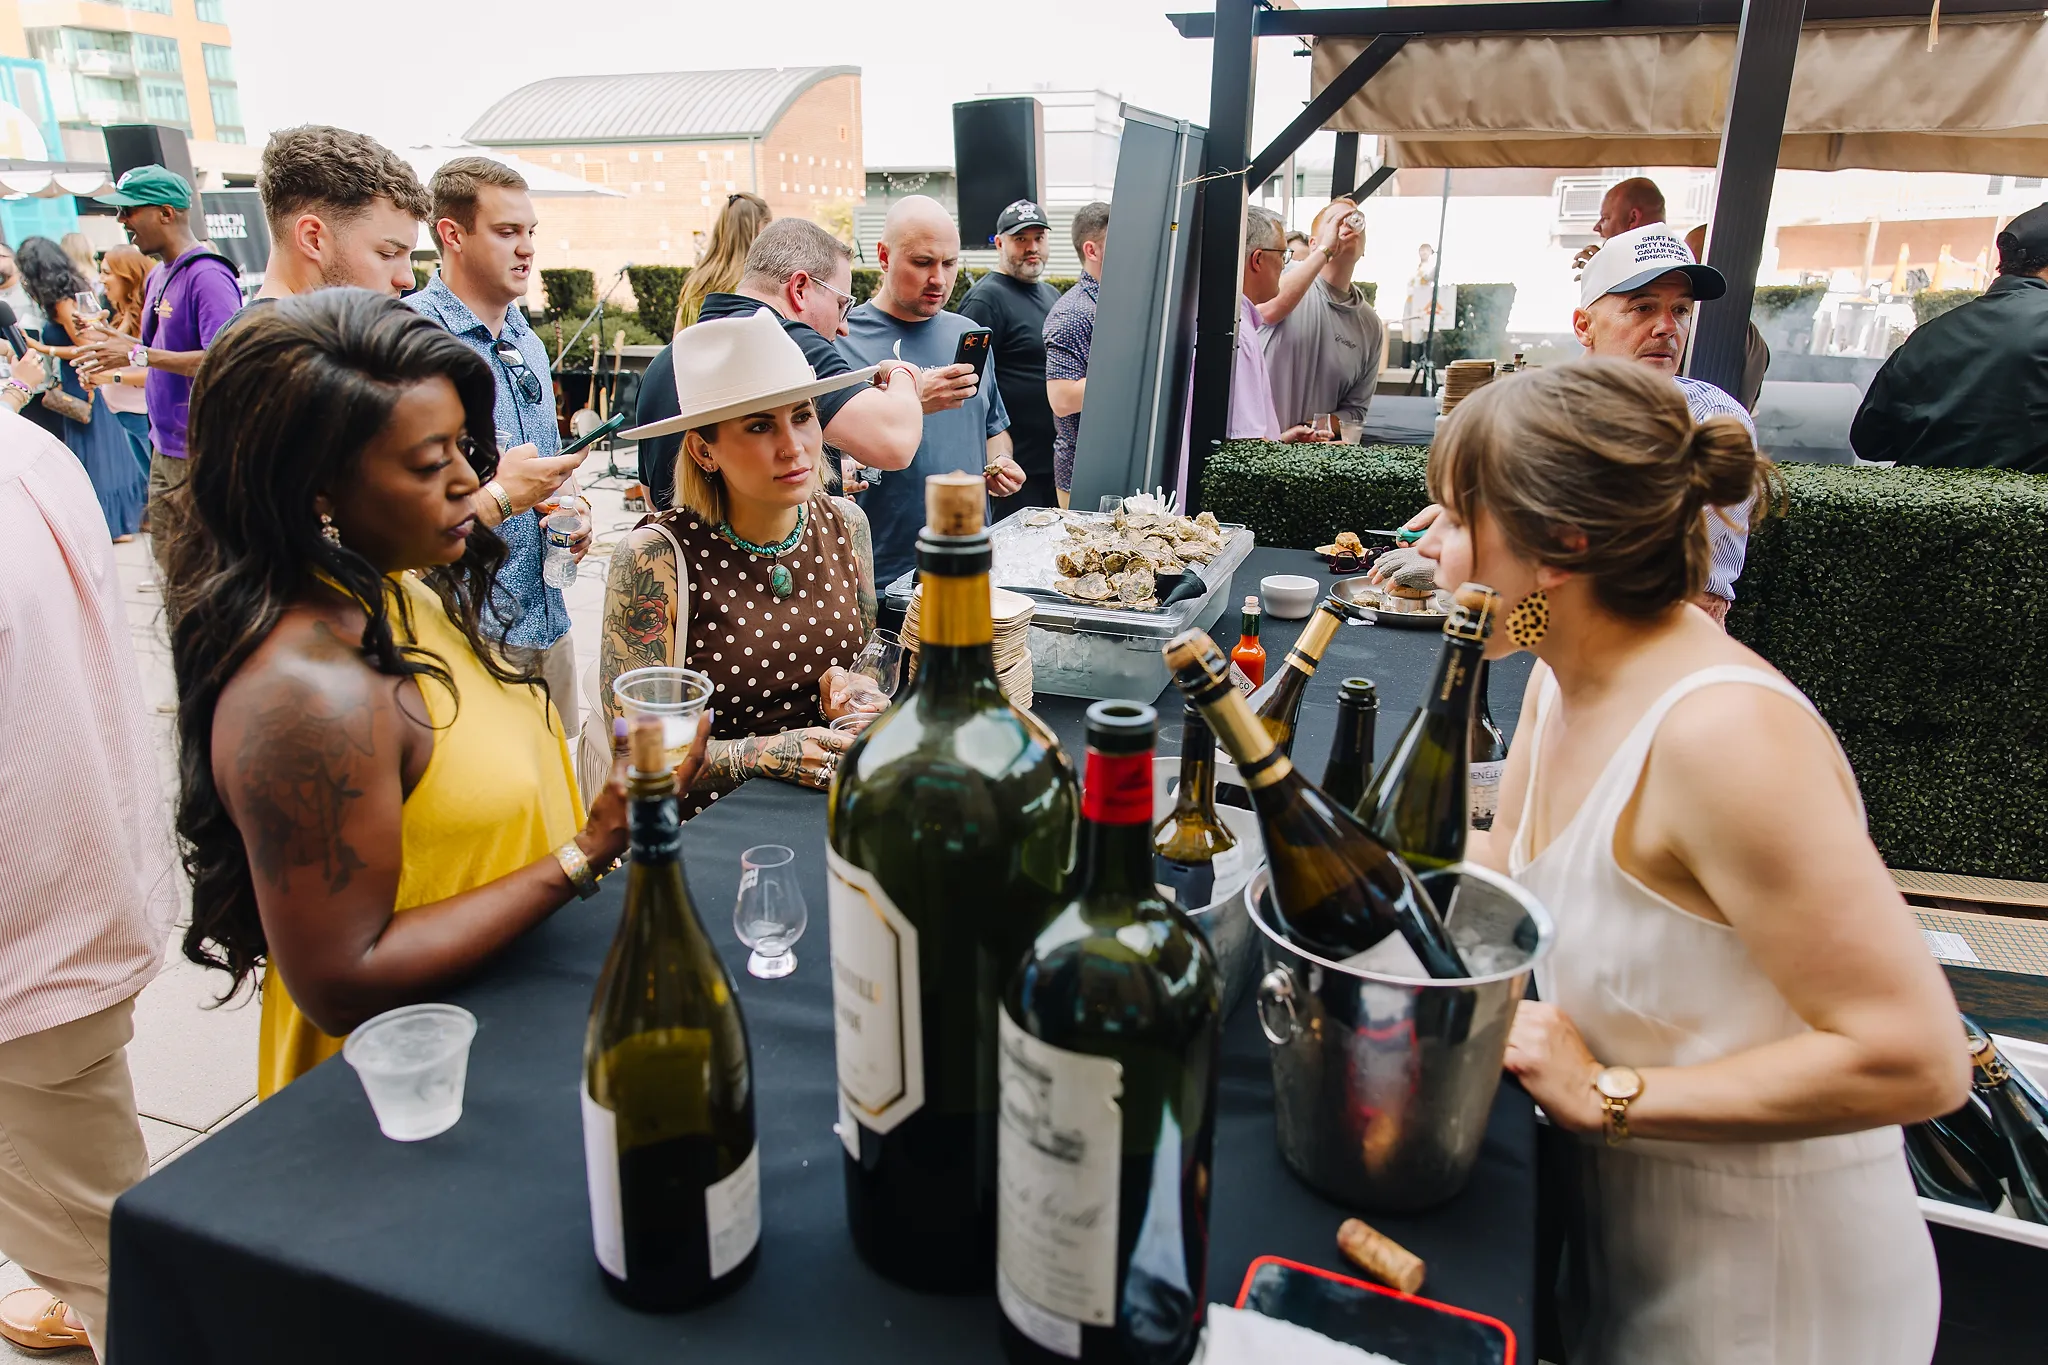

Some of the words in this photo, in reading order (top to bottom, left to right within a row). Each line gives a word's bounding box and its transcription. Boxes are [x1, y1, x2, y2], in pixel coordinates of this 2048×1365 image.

[1634, 242, 1658, 250] DIRTY
[1637, 248, 1667, 256] CAVIAR
[1635, 254, 1672, 263] MIDNIGHT
